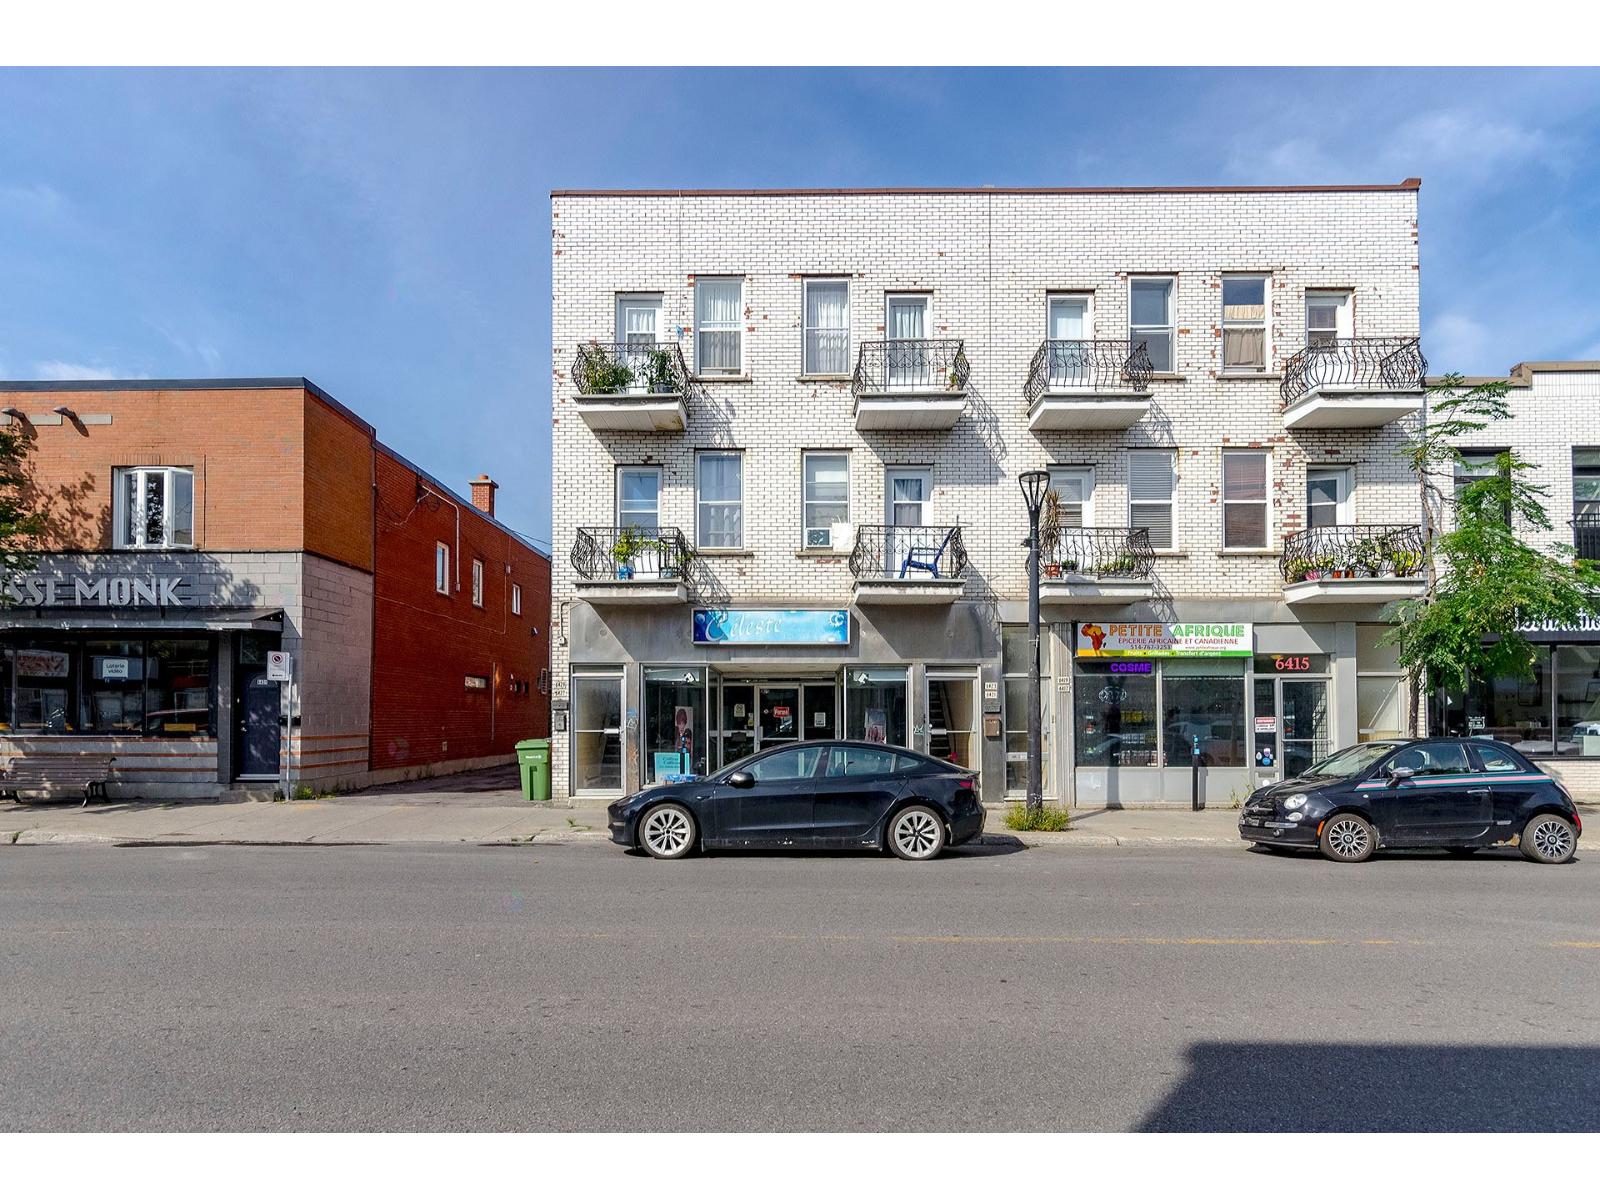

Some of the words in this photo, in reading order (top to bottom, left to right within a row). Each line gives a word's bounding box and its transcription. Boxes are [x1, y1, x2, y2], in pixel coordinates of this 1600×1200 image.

[75, 577, 183, 606] MONK
[1109, 624, 1163, 637] PETITE
[1172, 624, 1245, 638] AFRIQUE
[1110, 663, 1152, 673] COSME
[1275, 656, 1310, 670] 6415
